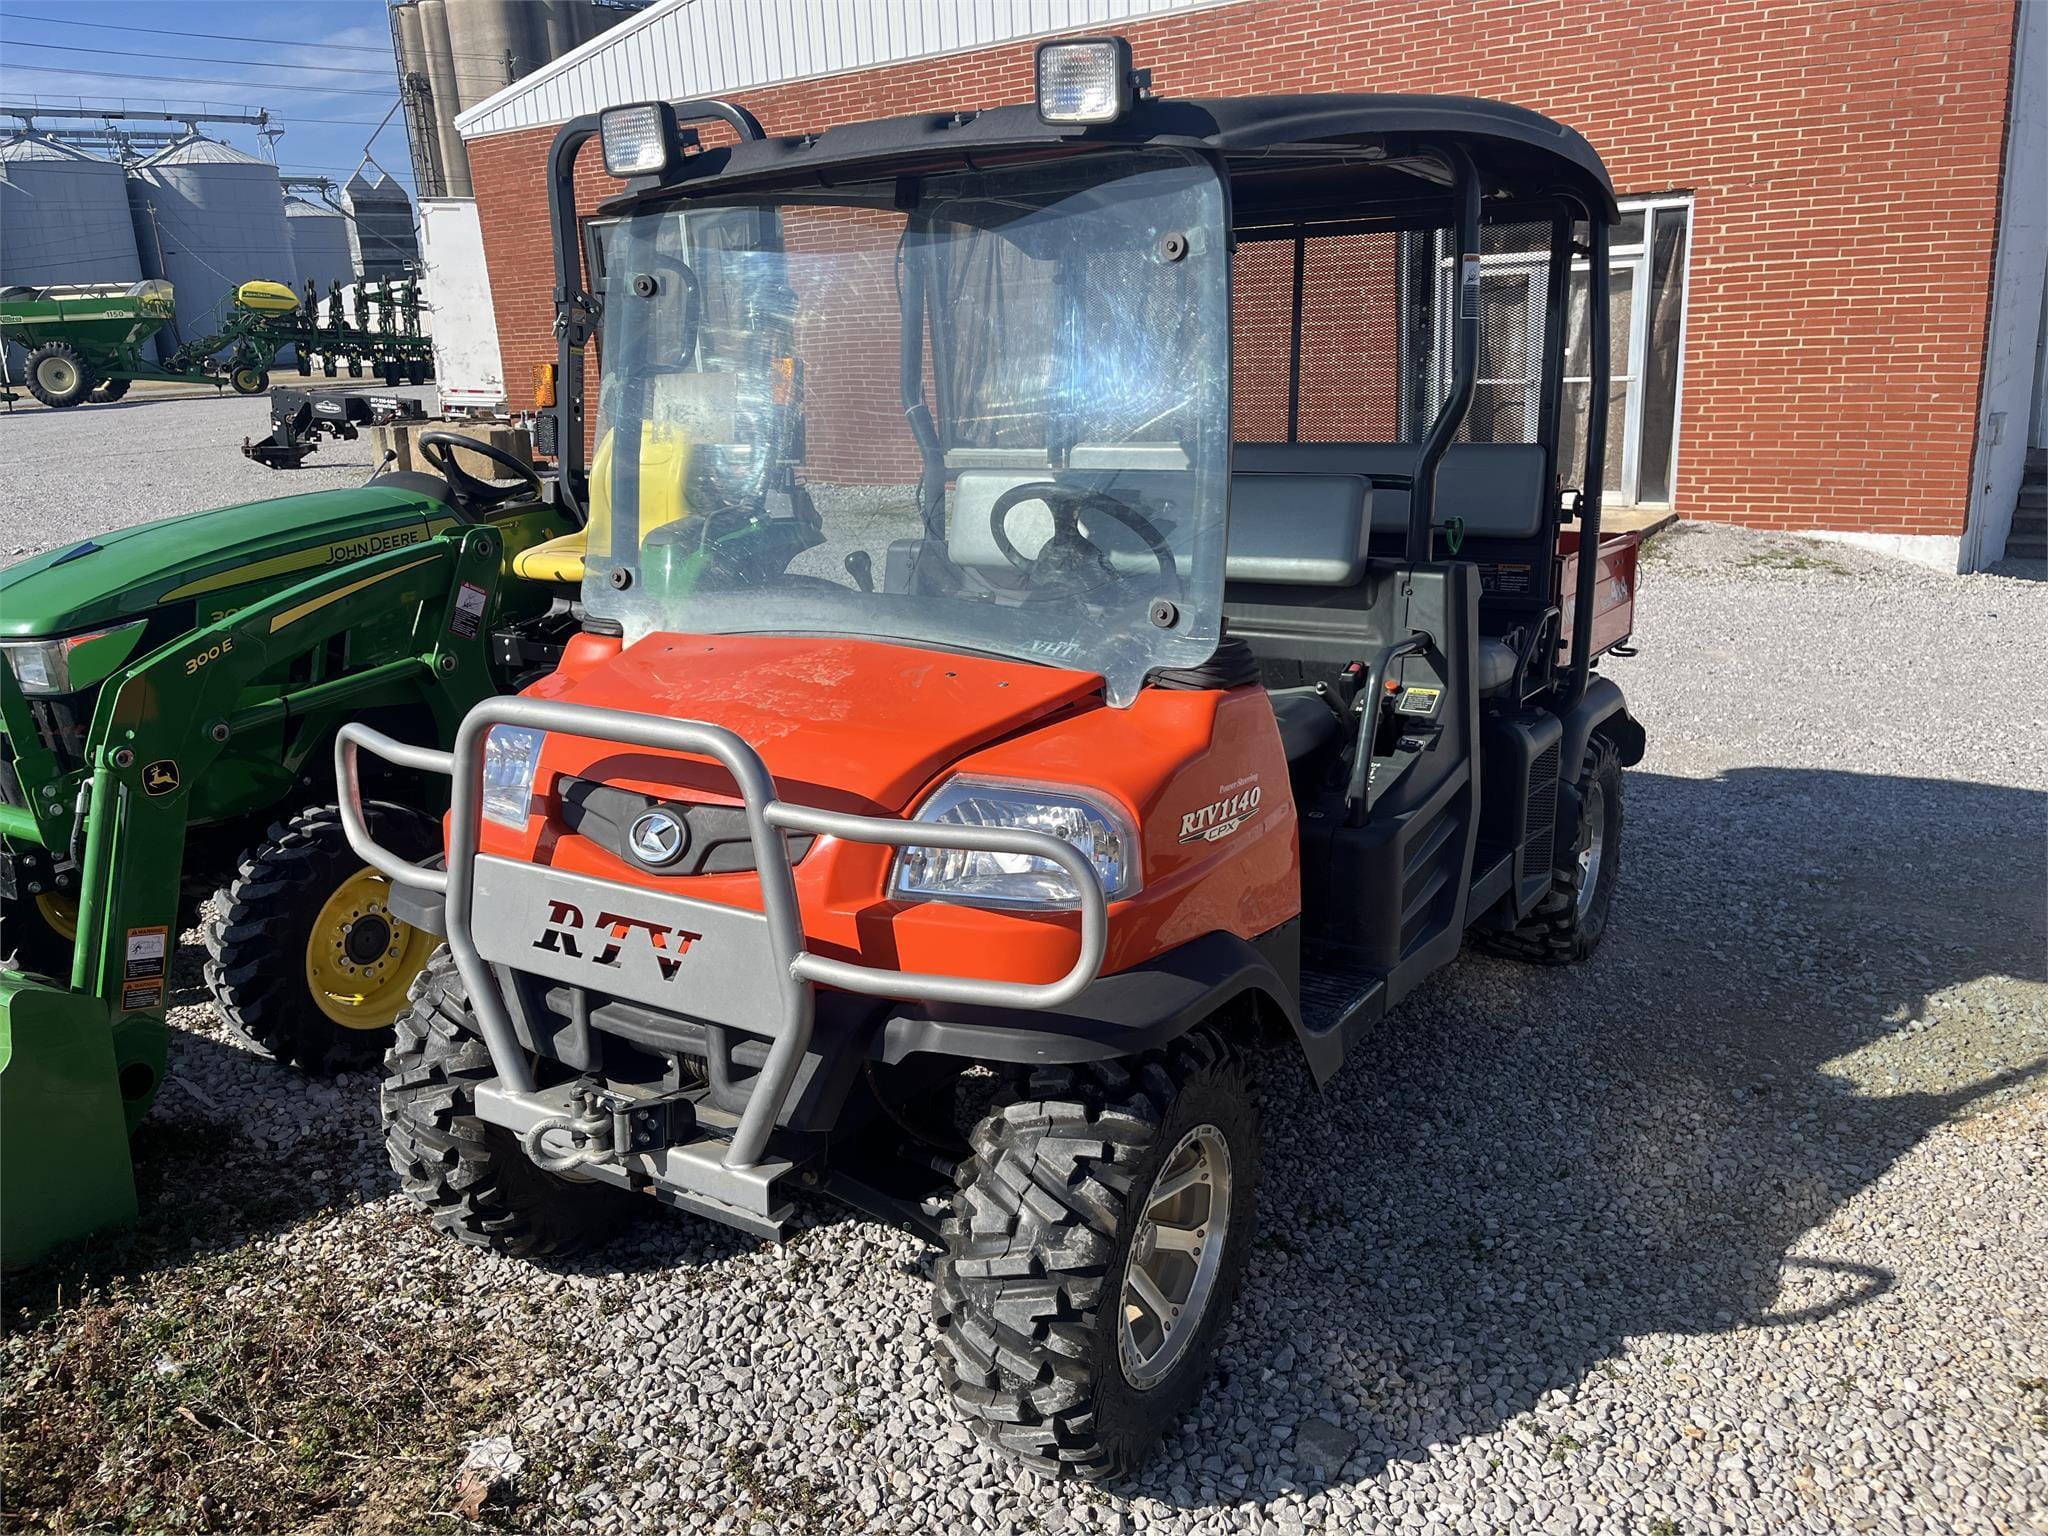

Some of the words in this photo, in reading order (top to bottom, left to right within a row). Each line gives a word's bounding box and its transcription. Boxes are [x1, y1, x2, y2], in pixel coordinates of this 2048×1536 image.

[325, 540, 369, 565] JOHN
[369, 530, 419, 553] DEERE
[1179, 786, 1262, 838] RTV1140
[1208, 821, 1235, 840] CPX
[532, 899, 703, 983] RTV
